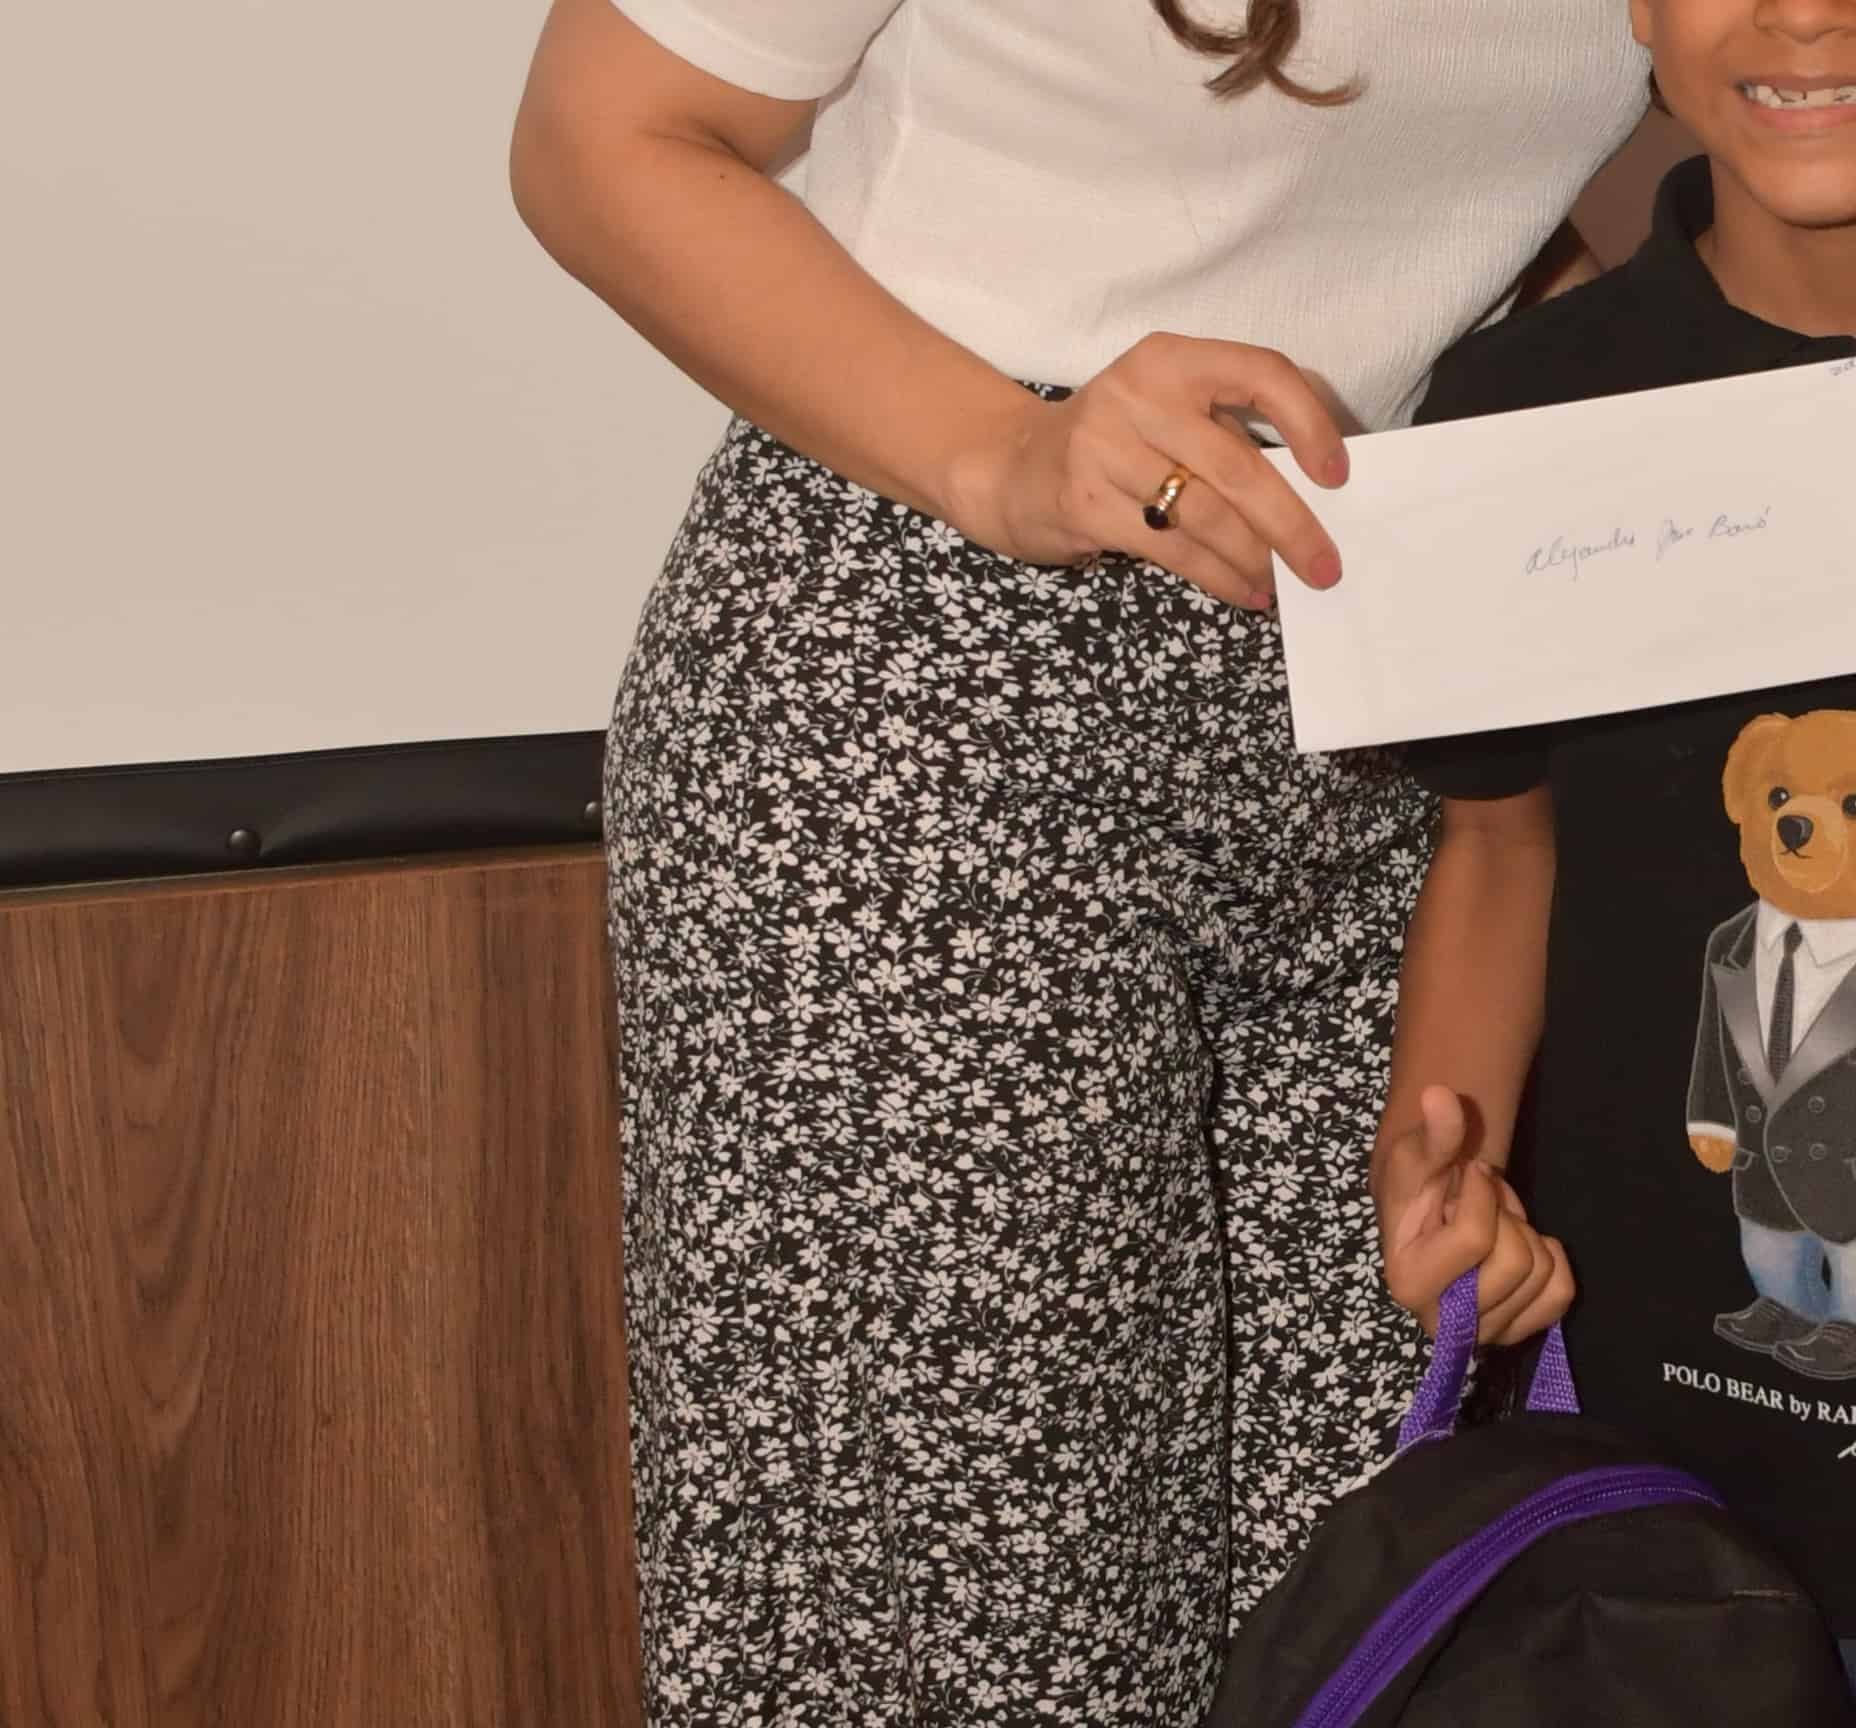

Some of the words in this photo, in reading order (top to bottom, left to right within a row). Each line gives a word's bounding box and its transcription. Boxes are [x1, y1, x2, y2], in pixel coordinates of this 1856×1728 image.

[1663, 1362, 1721, 1393] POLO
[1726, 1378, 1784, 1412] BEAR
[1789, 1393, 1811, 1421] by
